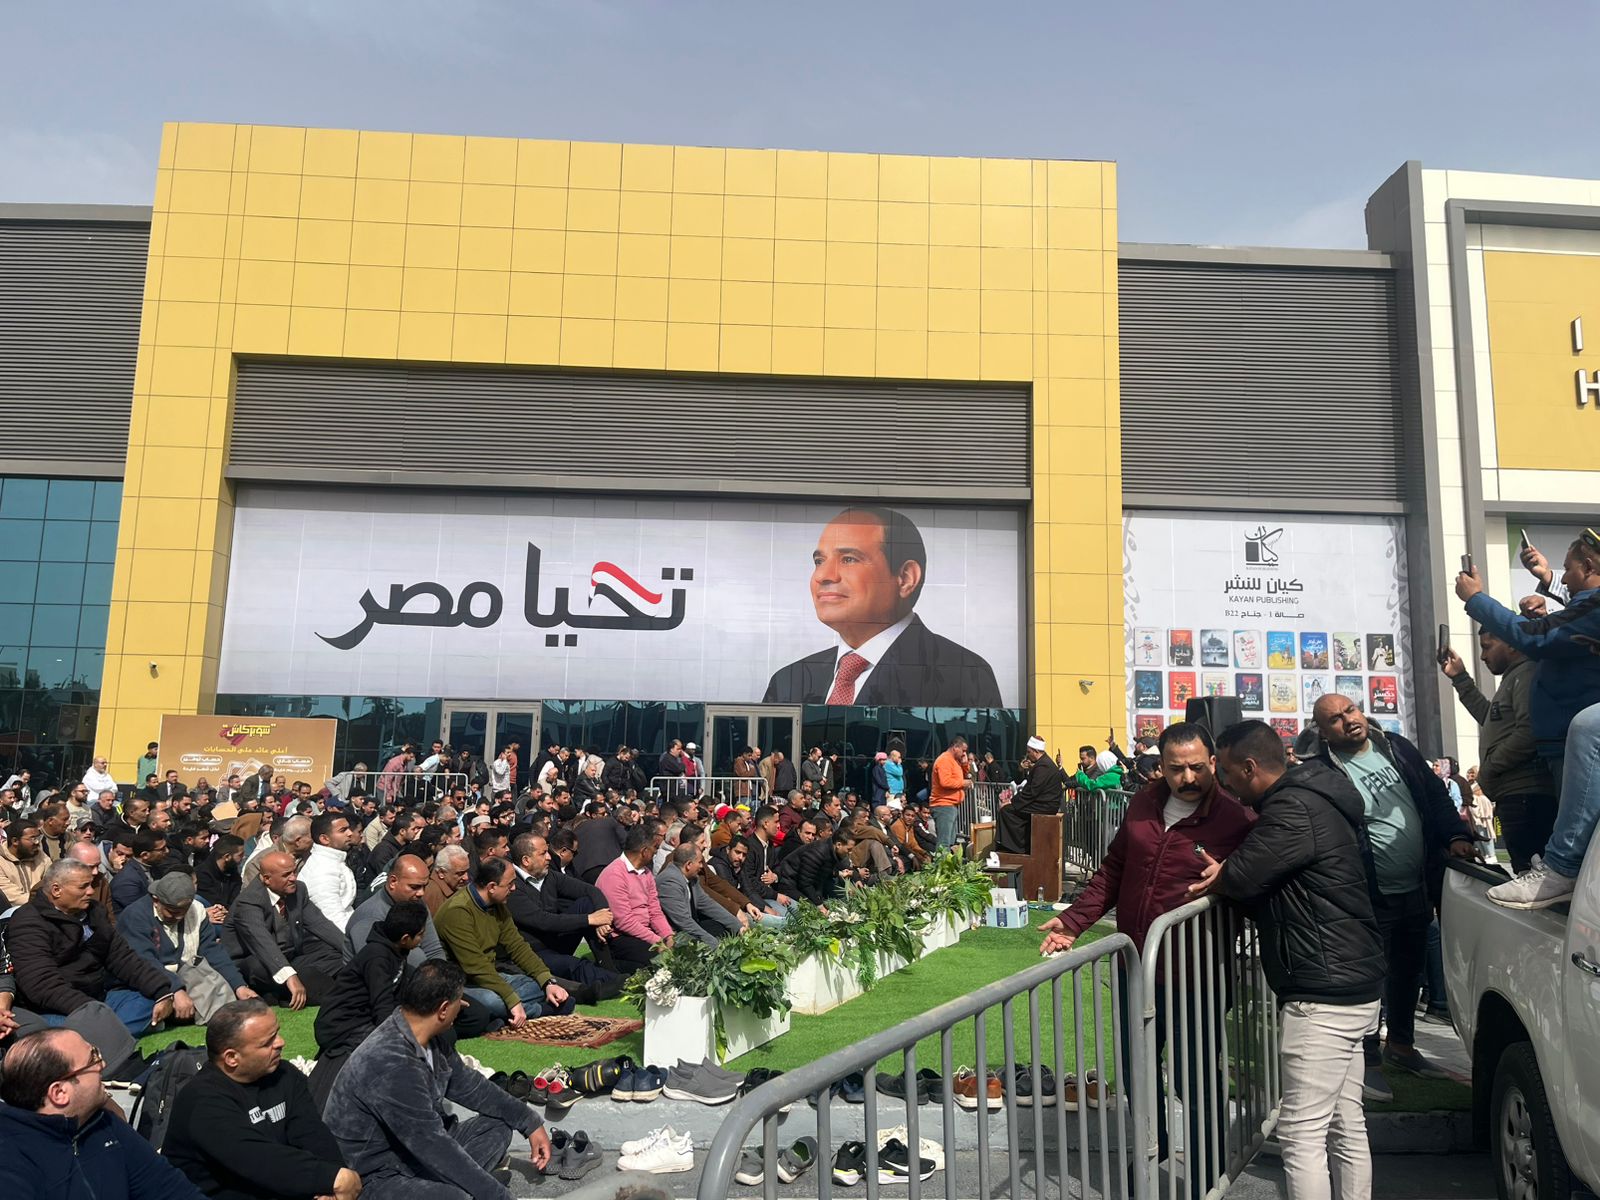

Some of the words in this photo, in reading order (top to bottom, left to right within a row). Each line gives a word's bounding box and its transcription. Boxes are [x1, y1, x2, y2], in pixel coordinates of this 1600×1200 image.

[1224, 574, 1261, 594] للنشر
[1266, 577, 1304, 595] كيان
[525, 541, 694, 647] تحيا
[1229, 596, 1255, 604] KAYAN
[1256, 596, 1299, 605] PUBLISHING
[314, 581, 503, 650] مصر
[1225, 609, 1239, 617] B22
